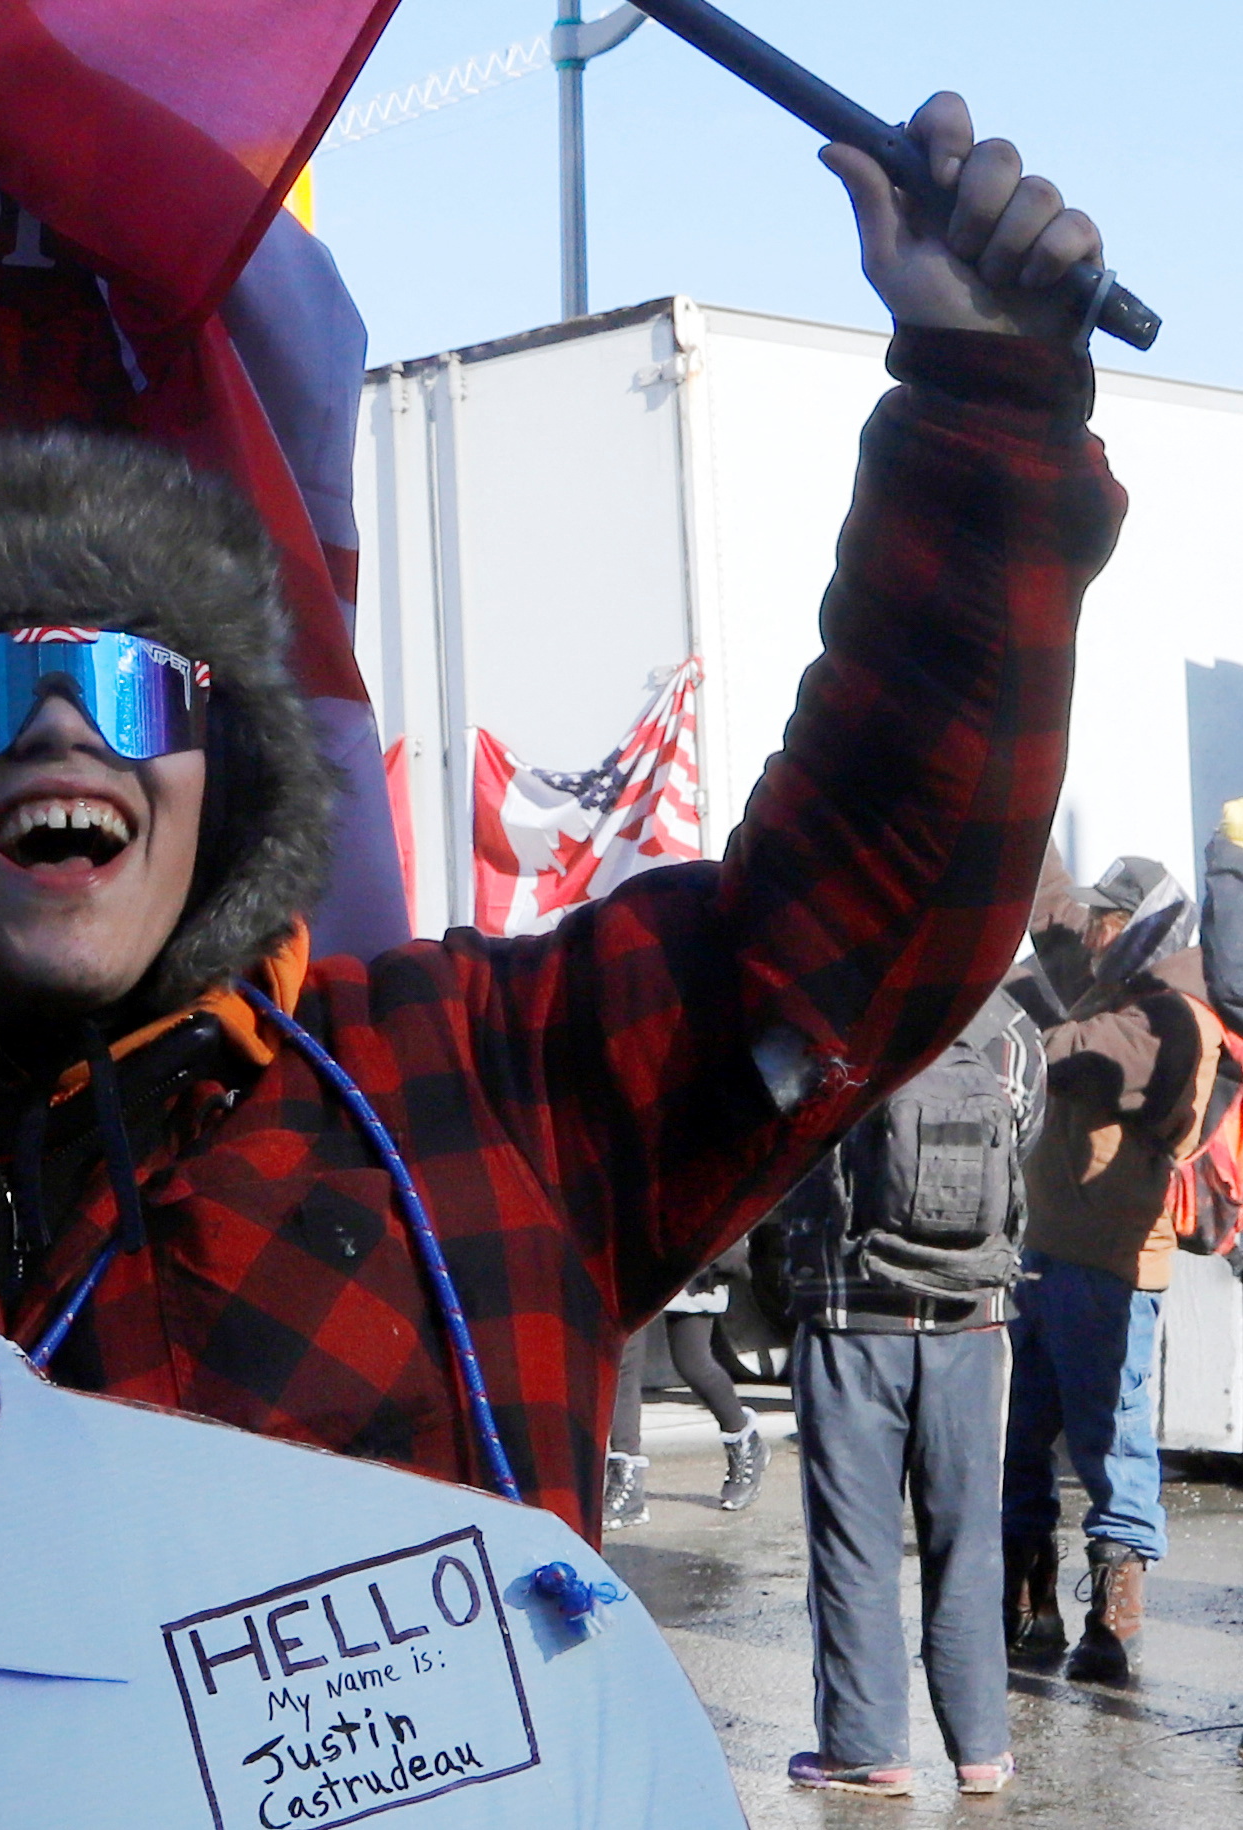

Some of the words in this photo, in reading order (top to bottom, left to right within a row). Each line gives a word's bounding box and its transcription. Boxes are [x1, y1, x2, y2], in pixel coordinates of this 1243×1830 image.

[188, 1555, 481, 1694] HELLO
[267, 1686, 310, 1733] My
[410, 1645, 446, 1674] is:
[242, 1707, 417, 1785] Justin
[258, 1742, 484, 1830] Castrudeau
